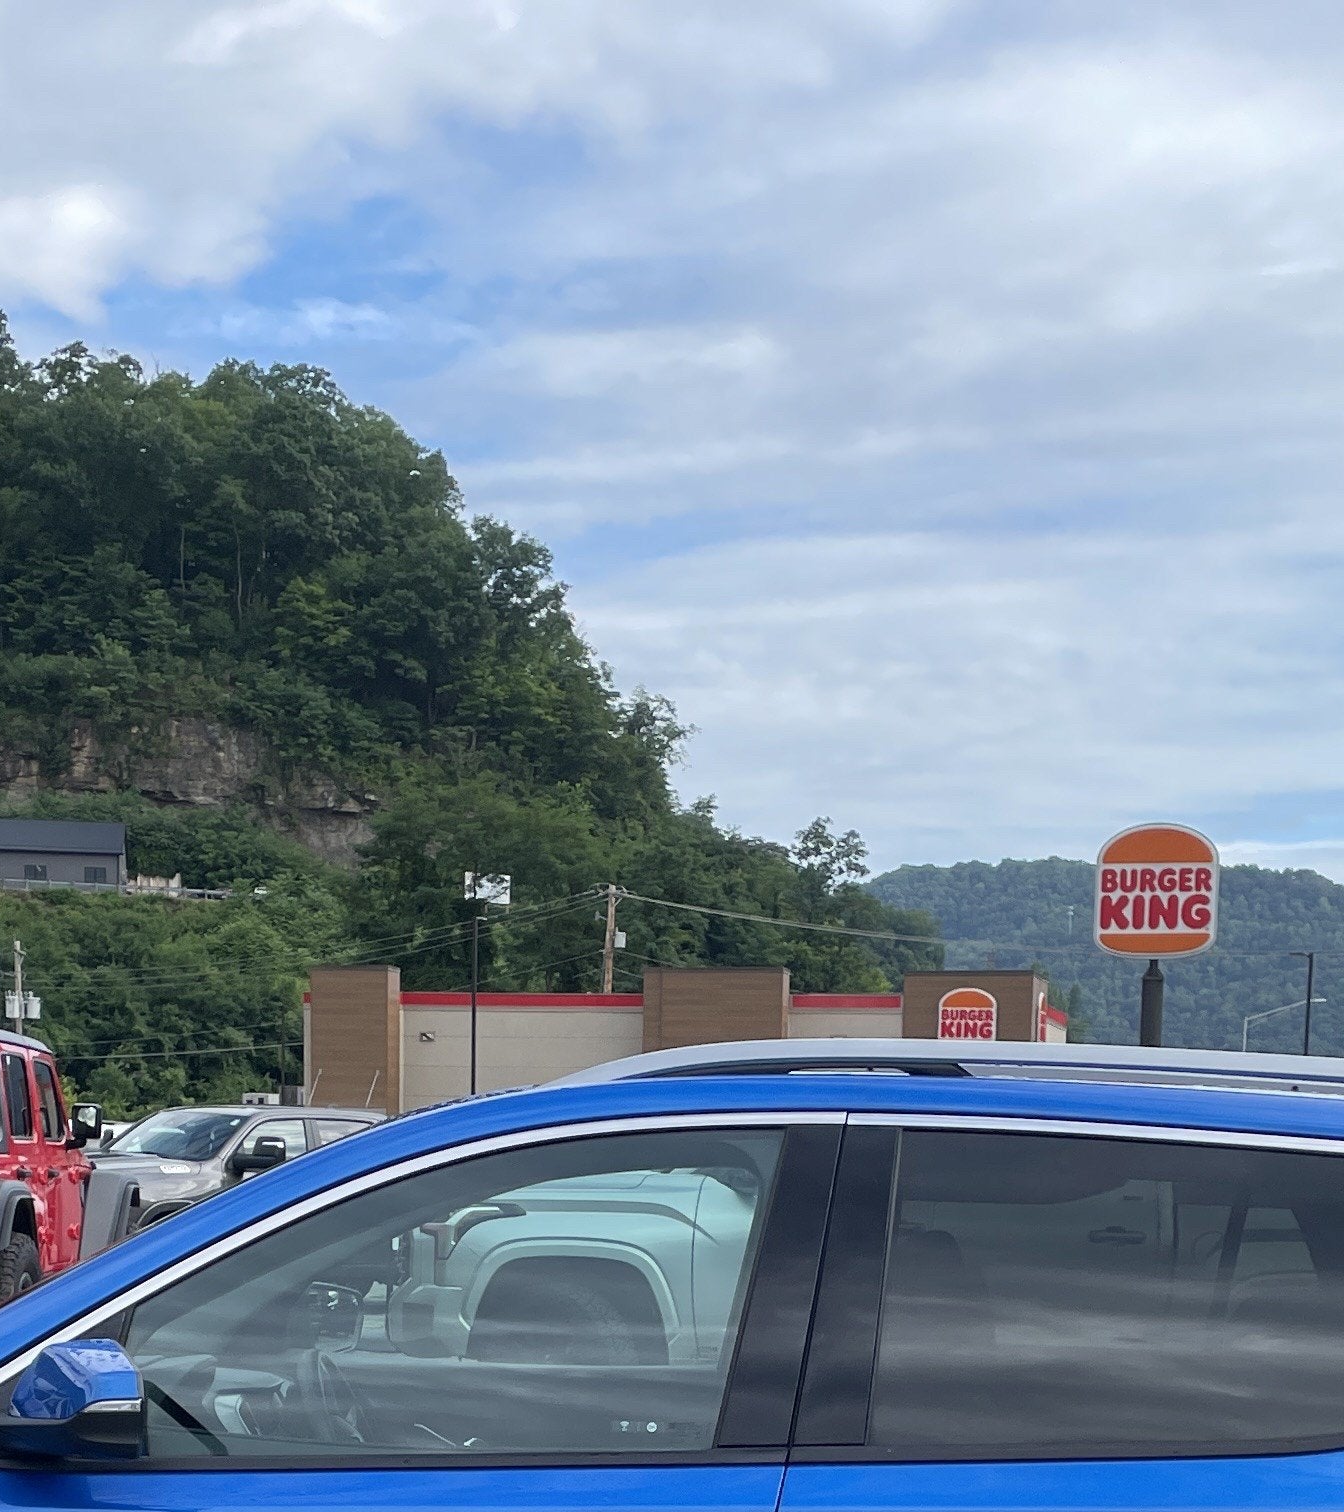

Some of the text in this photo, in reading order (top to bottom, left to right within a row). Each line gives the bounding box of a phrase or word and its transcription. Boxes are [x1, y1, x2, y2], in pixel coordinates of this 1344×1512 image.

[1101, 867, 1212, 893] BURGER
[1099, 893, 1212, 930] KING
[941, 1008, 994, 1021] BURGER
[940, 1021, 994, 1039] KING
